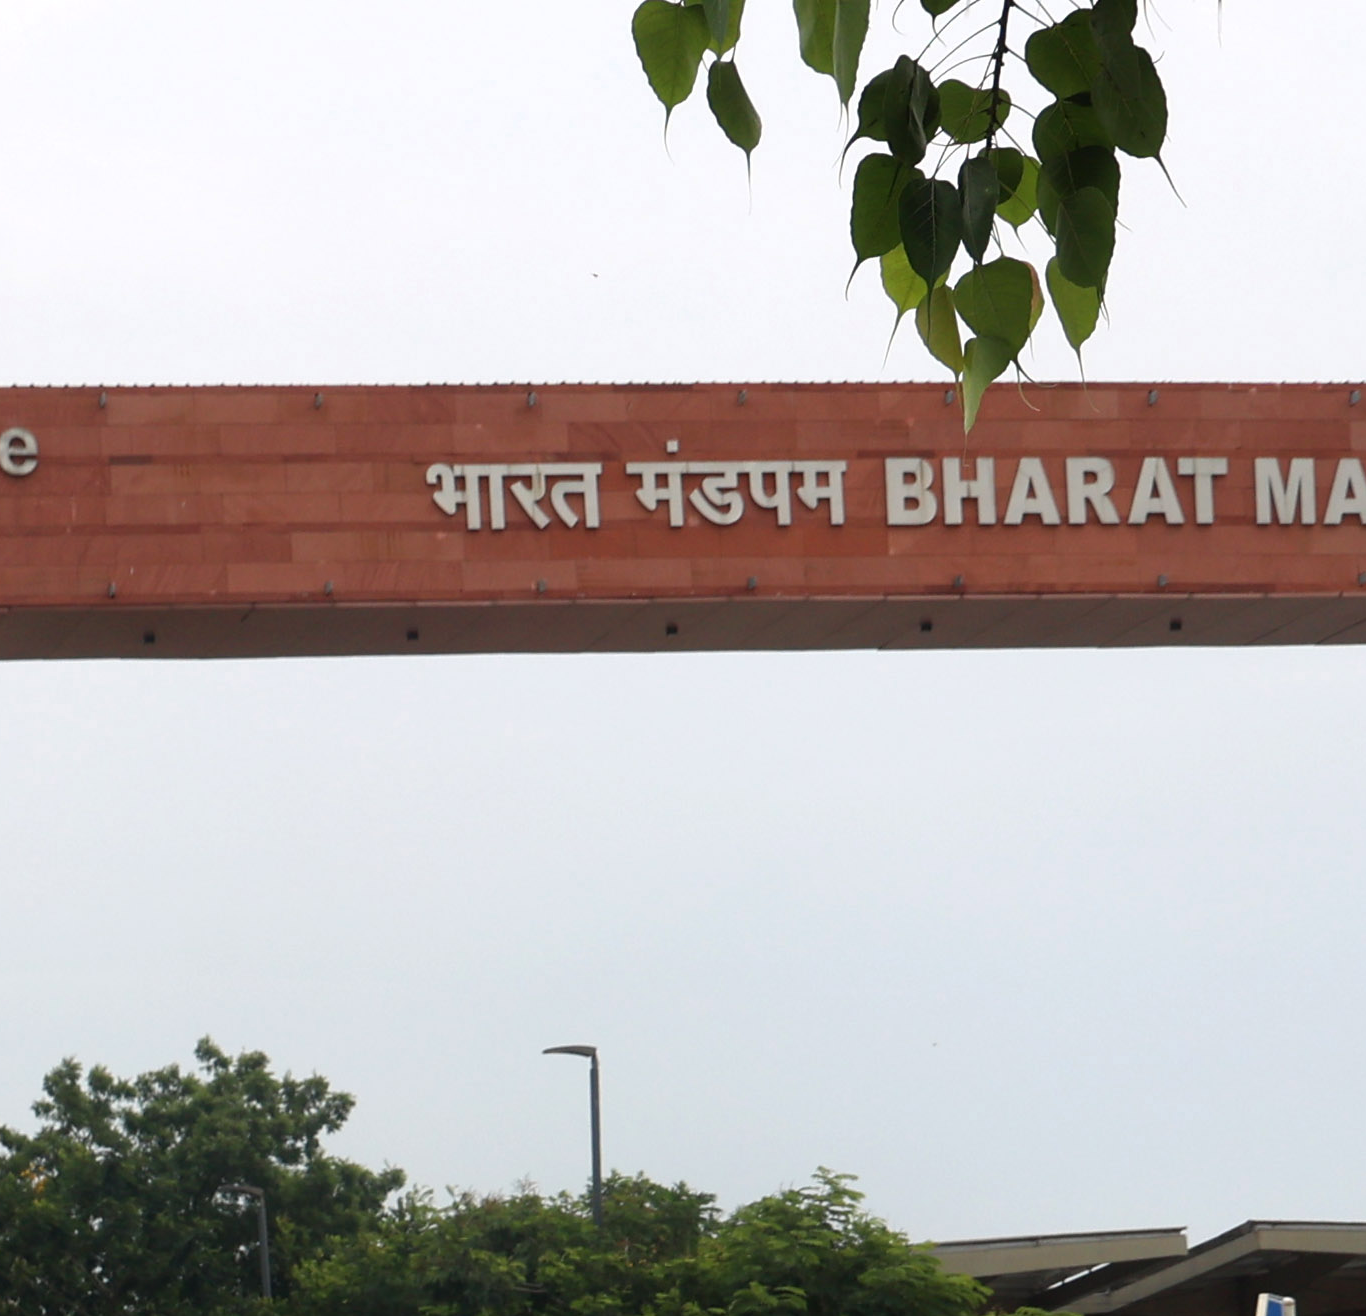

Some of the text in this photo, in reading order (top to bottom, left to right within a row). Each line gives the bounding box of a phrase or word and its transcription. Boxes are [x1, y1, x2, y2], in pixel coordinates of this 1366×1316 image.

[425, 439, 848, 531] भारत मंडपम
[884, 456, 1228, 526] BHARAT
